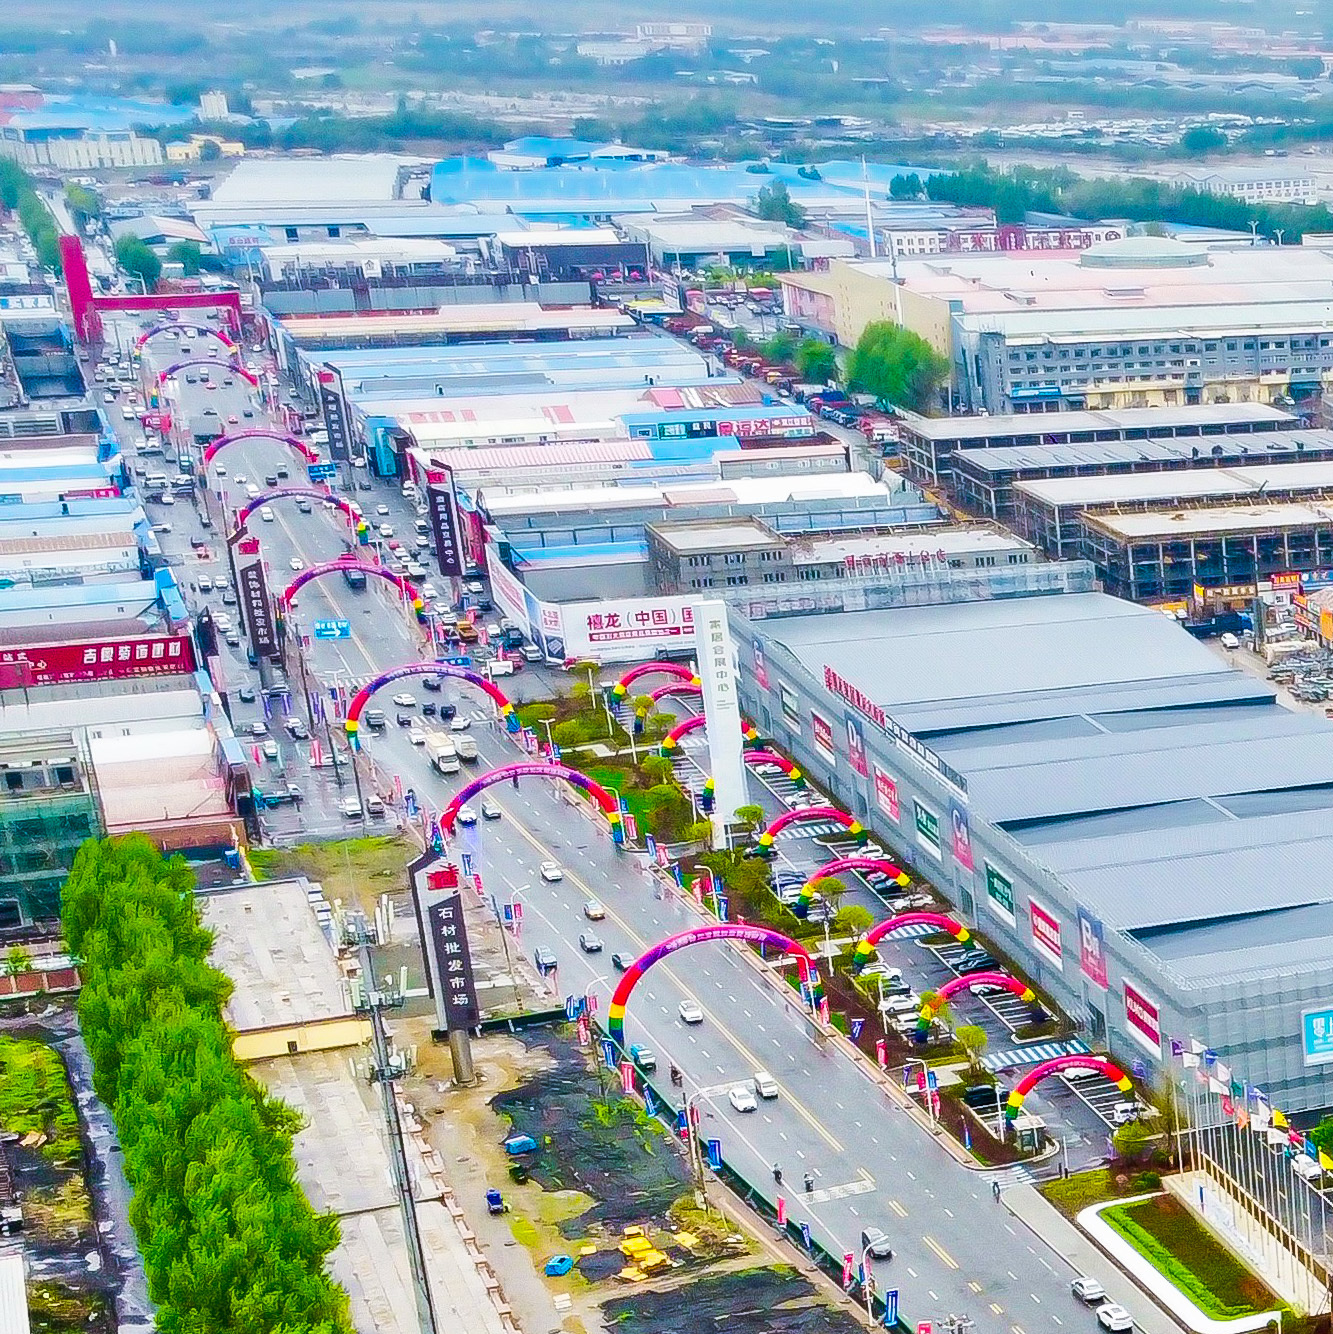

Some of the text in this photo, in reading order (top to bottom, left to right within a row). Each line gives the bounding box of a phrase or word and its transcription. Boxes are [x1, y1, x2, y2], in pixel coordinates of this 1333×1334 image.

[438, 906, 469, 1006] 石材批发市场
